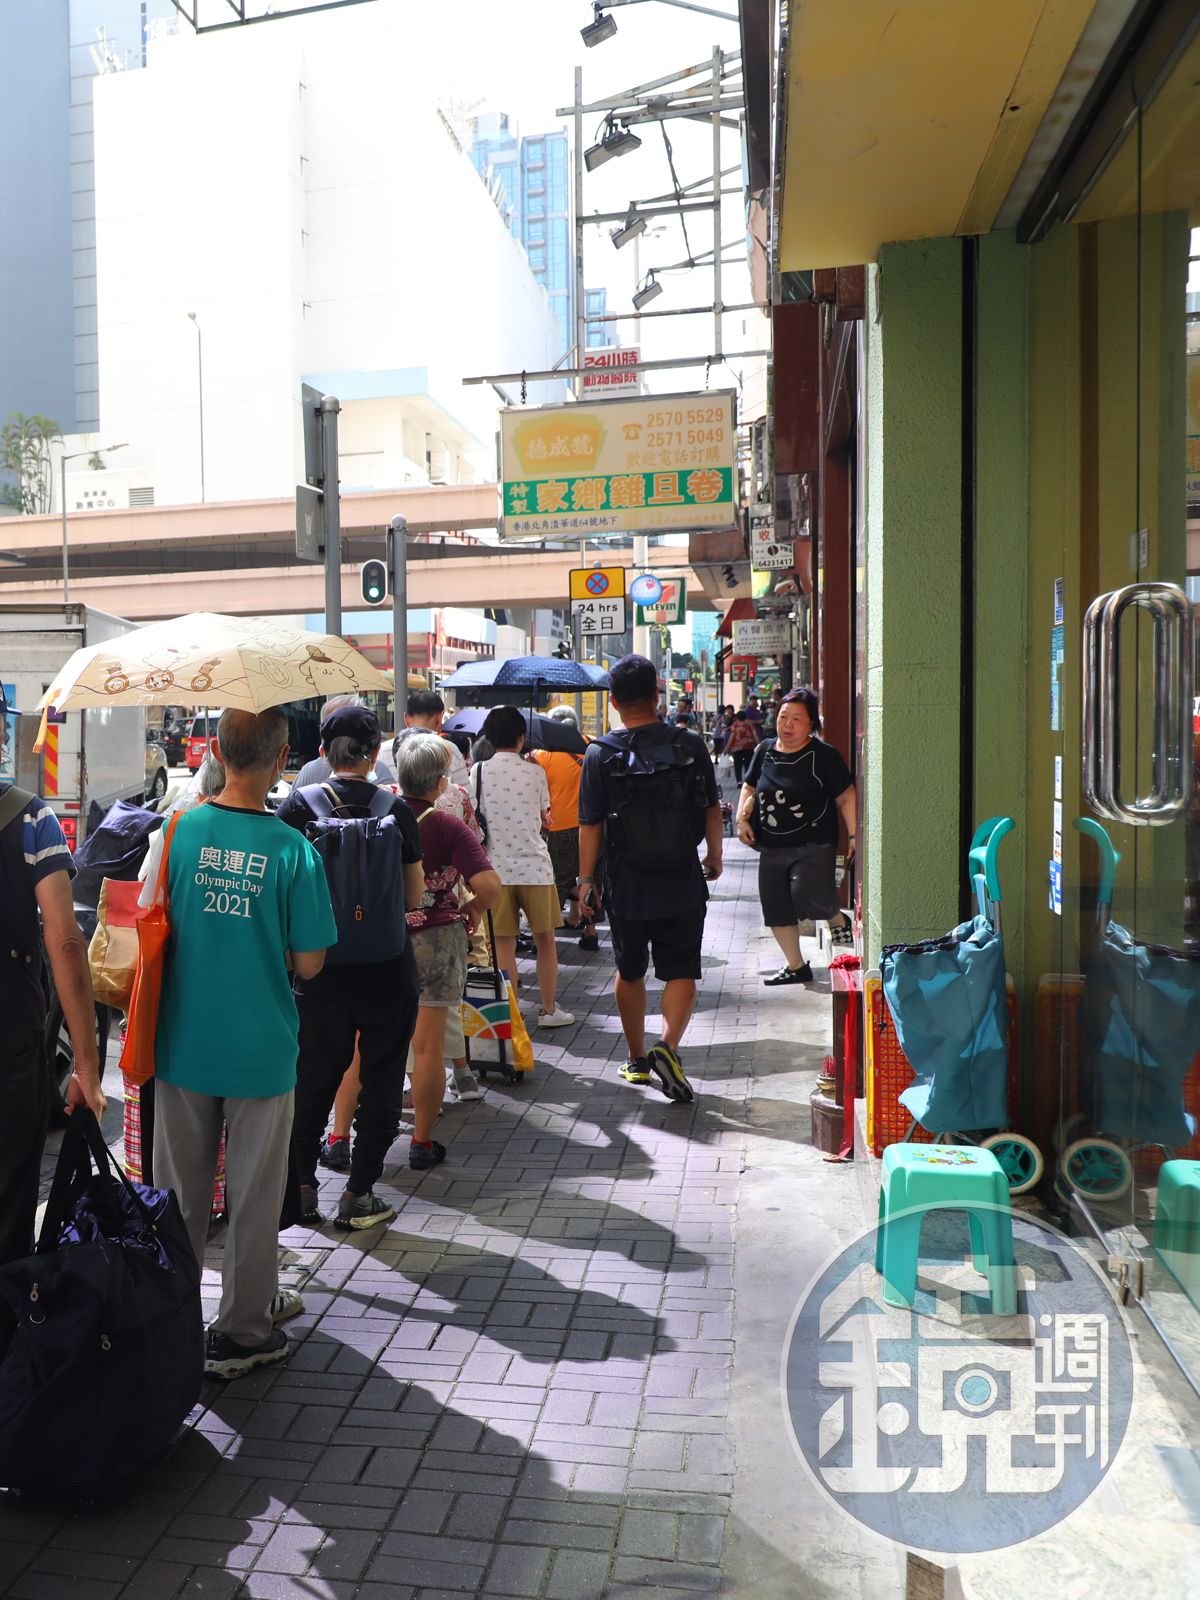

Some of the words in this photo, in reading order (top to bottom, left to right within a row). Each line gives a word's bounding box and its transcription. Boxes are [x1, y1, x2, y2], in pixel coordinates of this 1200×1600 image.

[646, 412, 683, 428] 2570
[687, 408, 724, 425] 5529
[647, 431, 683, 447] 2571
[687, 428, 724, 445] 5049
[578, 604, 595, 614] 24
[599, 603, 618, 612] hrs
[582, 616, 614, 632] 全日
[198, 846, 268, 879] 奧運日
[194, 872, 241, 892] Olympic
[242, 879, 264, 898] Day
[203, 891, 253, 918] 2021
